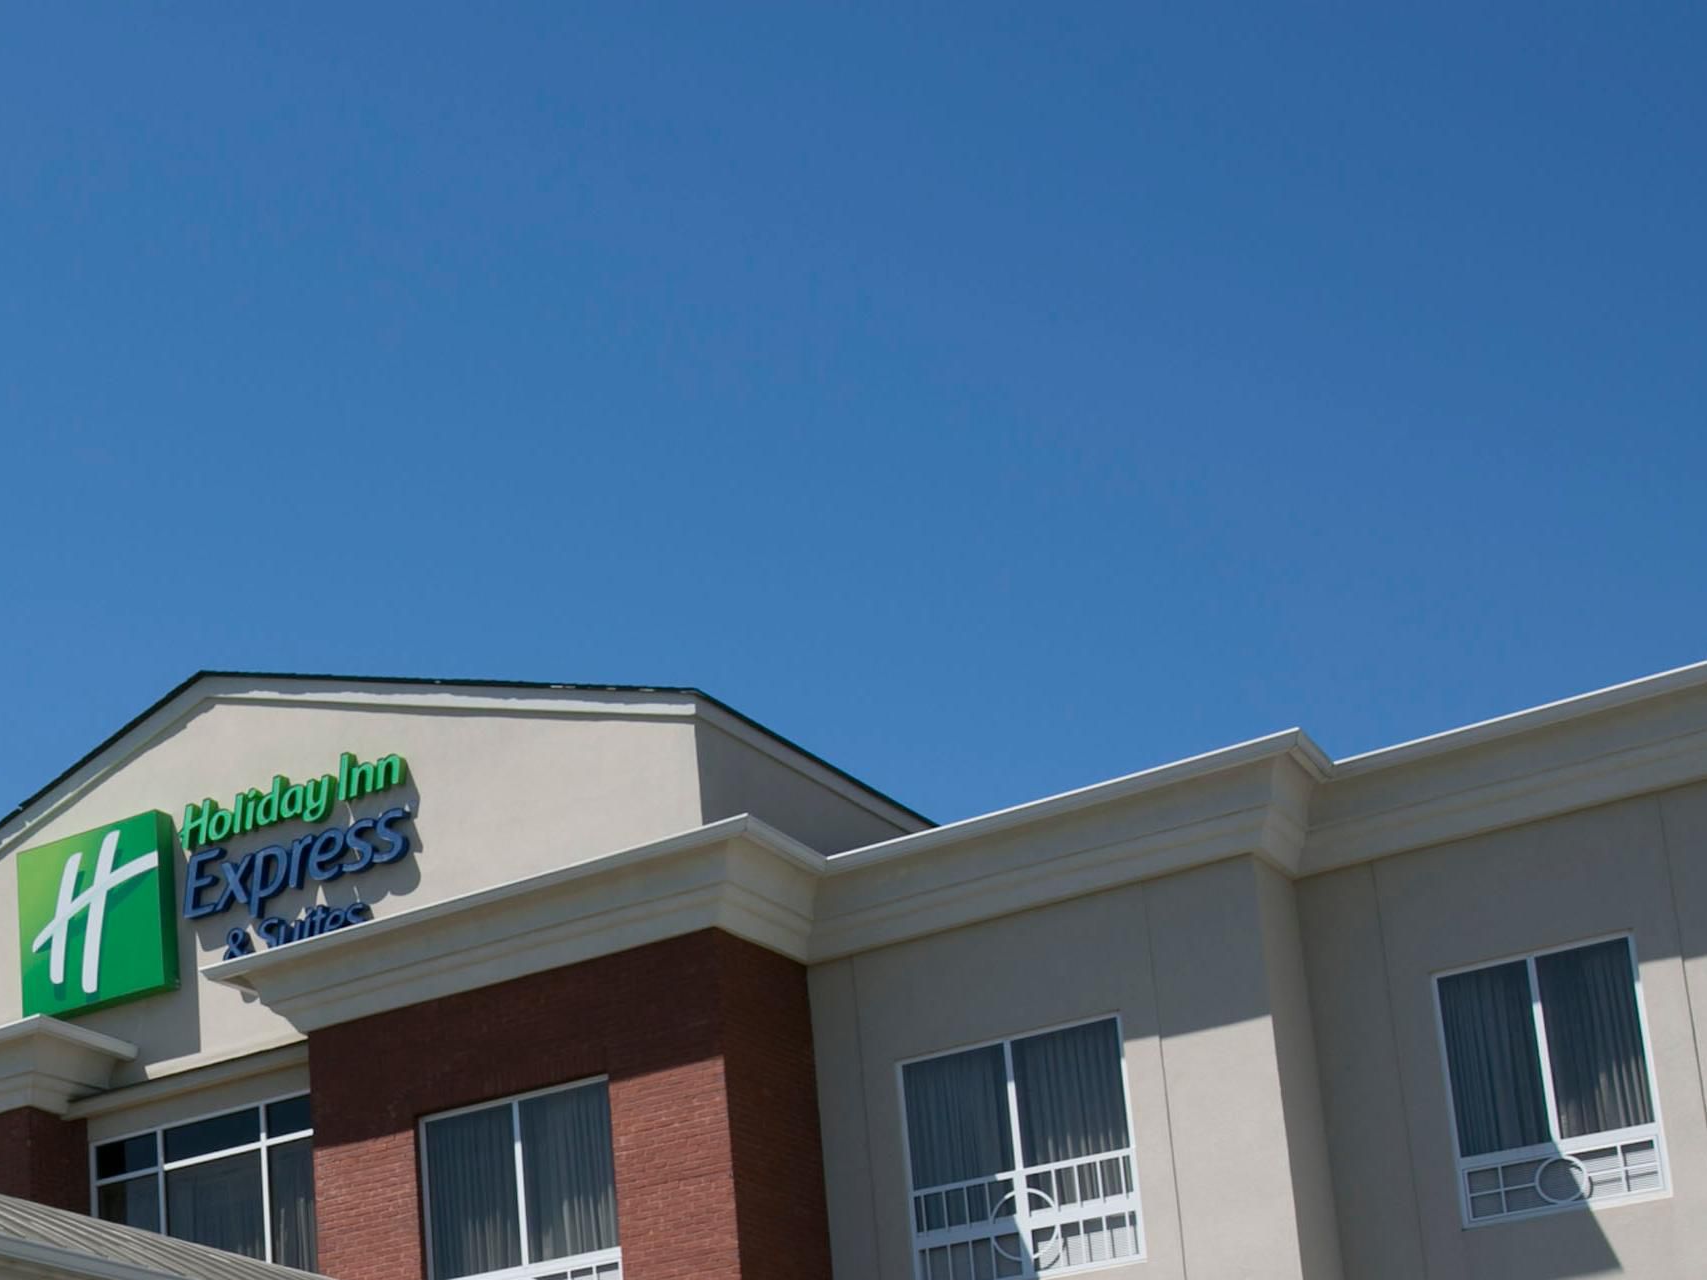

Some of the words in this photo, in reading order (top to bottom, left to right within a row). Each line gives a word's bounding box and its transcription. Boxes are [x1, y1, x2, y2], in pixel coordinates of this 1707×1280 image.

[180, 774, 336, 849] Holiday
[336, 752, 407, 802] Inn
[183, 807, 411, 920] Express
[223, 927, 255, 961] &
[258, 902, 373, 949] Suites
